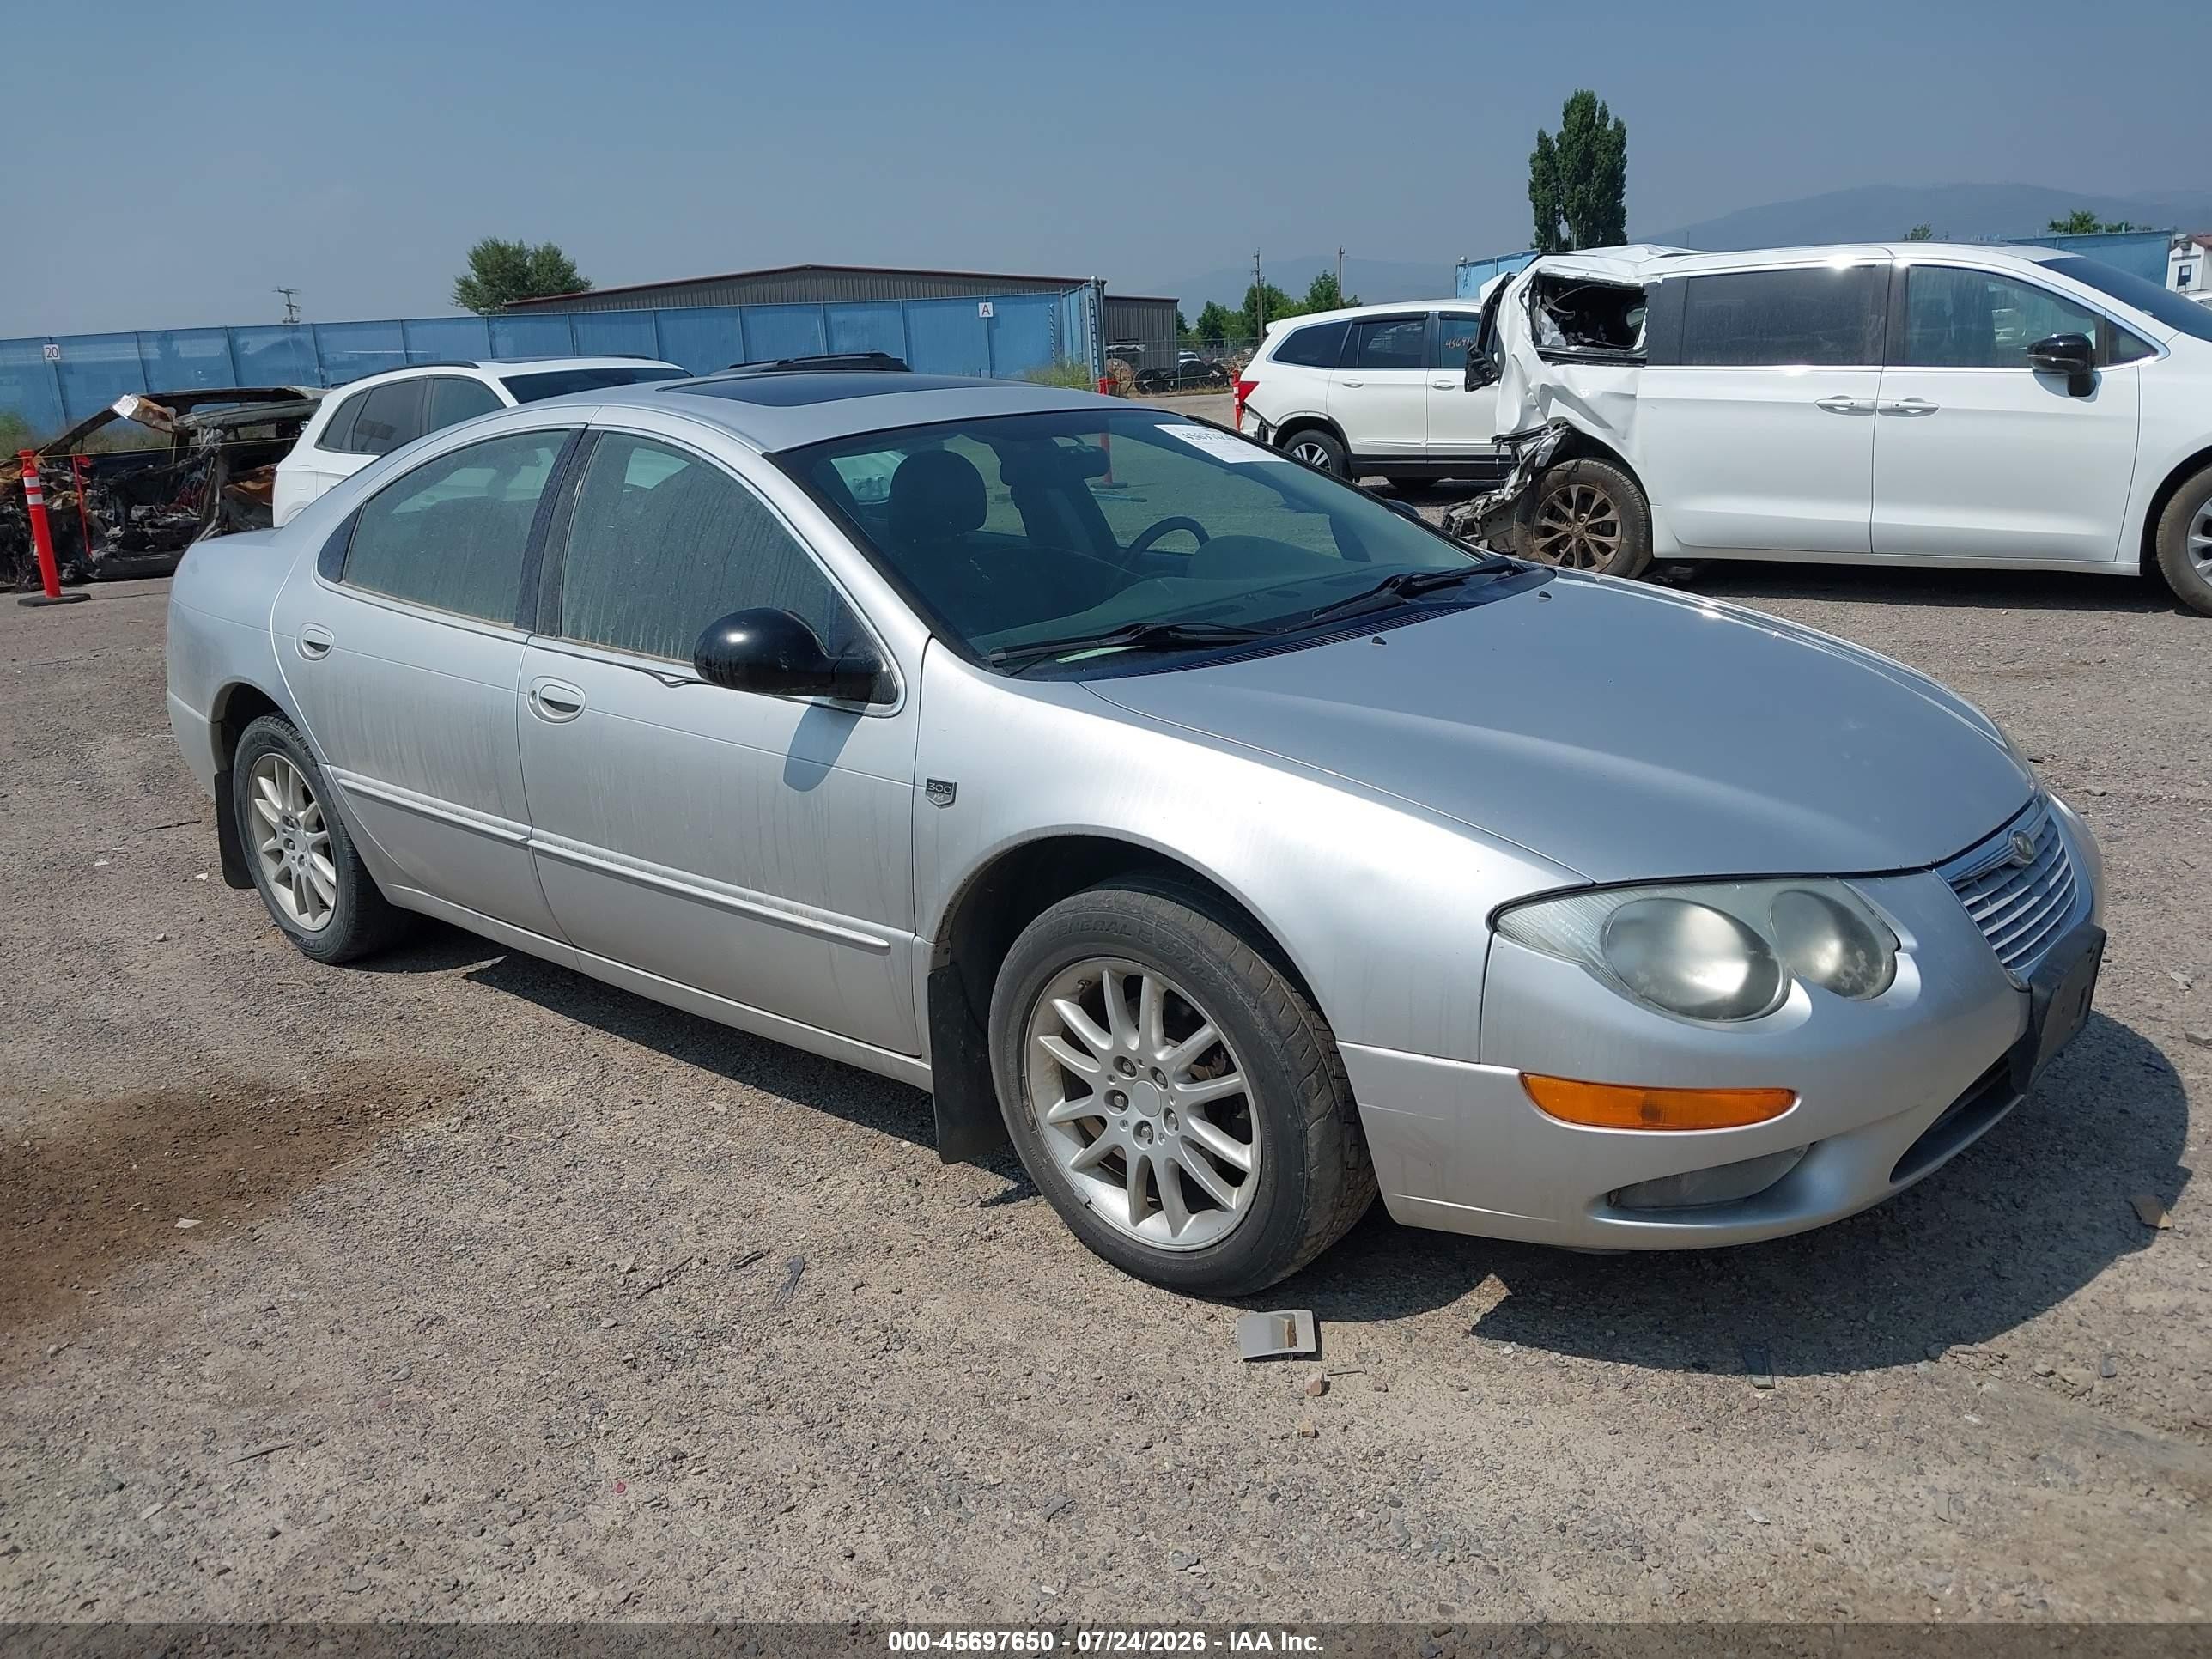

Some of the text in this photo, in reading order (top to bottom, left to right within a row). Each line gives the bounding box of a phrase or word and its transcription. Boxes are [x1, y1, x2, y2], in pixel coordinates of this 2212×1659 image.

[981, 304, 991, 316] A
[45, 346, 58, 358] 20
[927, 782, 952, 794] 300
